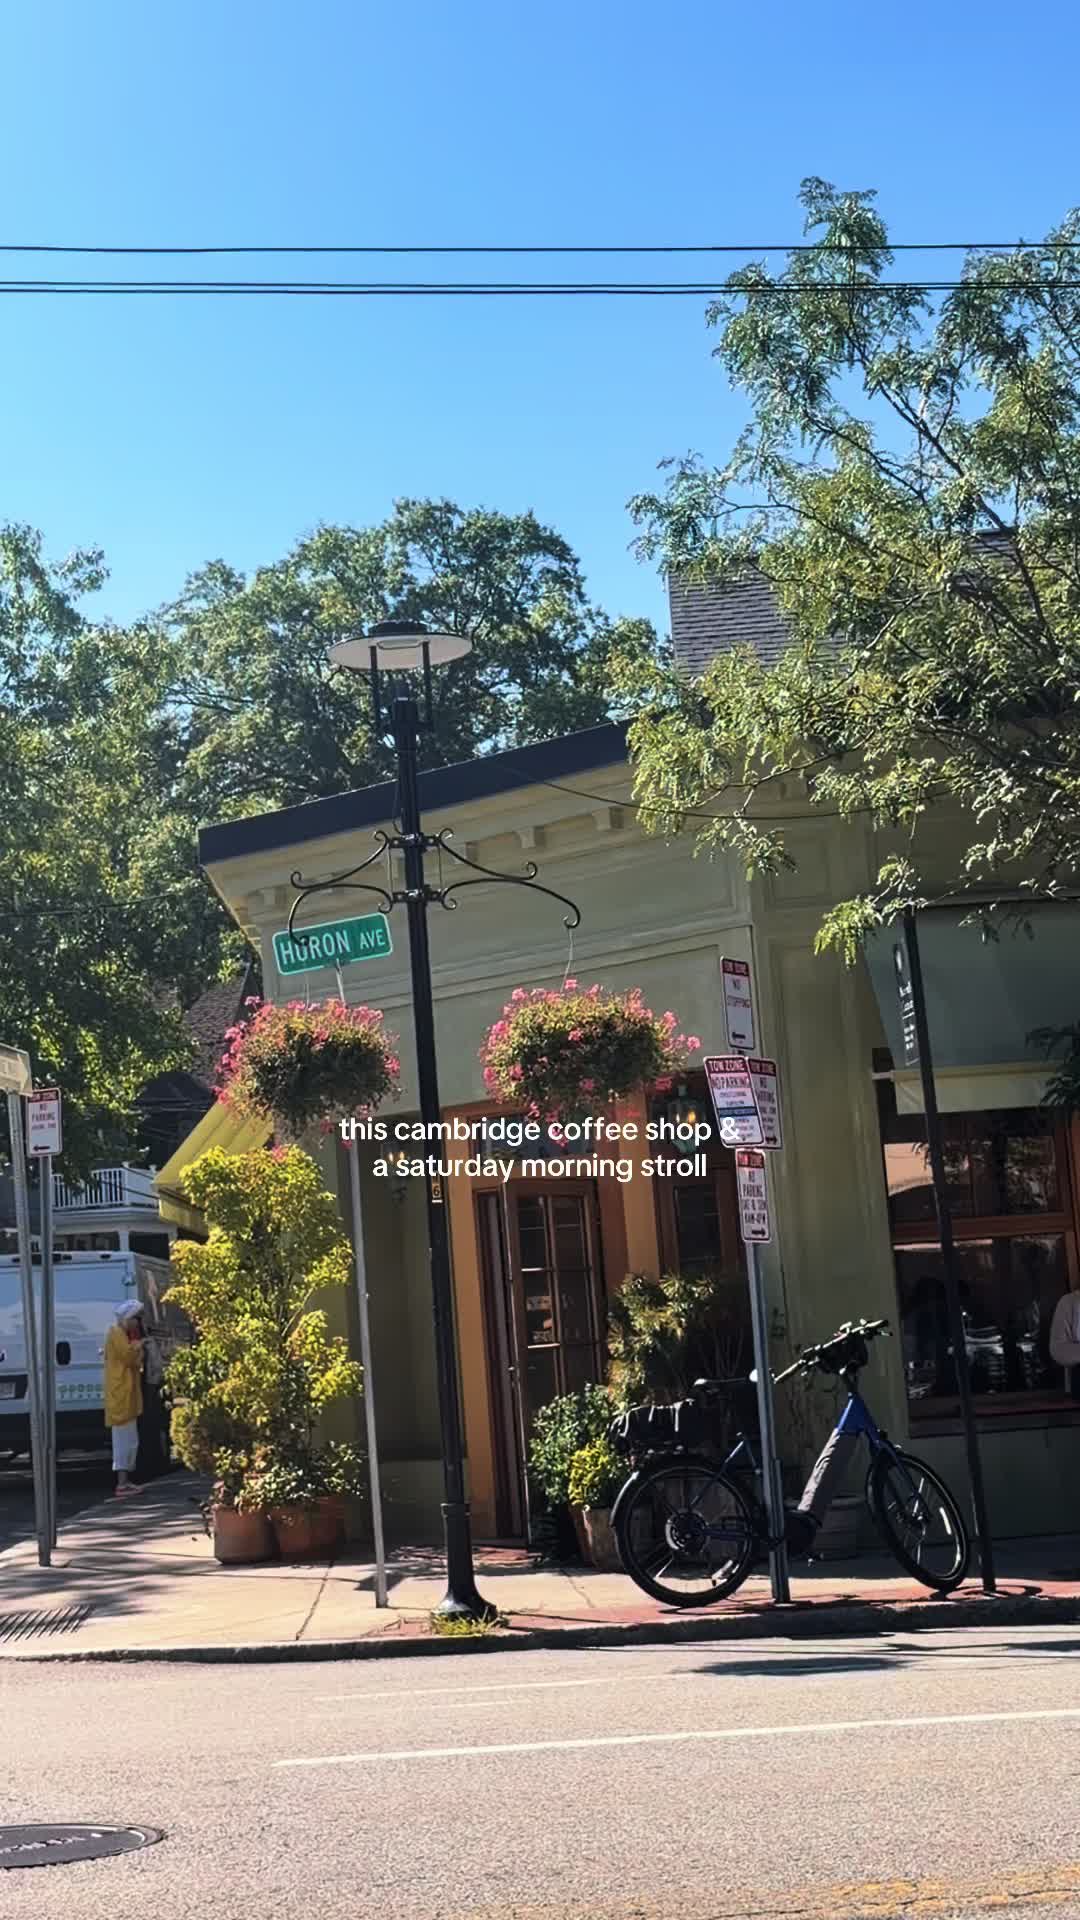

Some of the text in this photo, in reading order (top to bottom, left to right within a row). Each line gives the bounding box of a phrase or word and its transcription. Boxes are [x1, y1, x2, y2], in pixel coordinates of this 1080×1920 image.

[280, 929, 386, 966] HURON AVE
[708, 1060, 746, 1072] TOW ZONE
[711, 1075, 751, 1089] NO PARKING
[742, 1184, 763, 1198] PARKING
